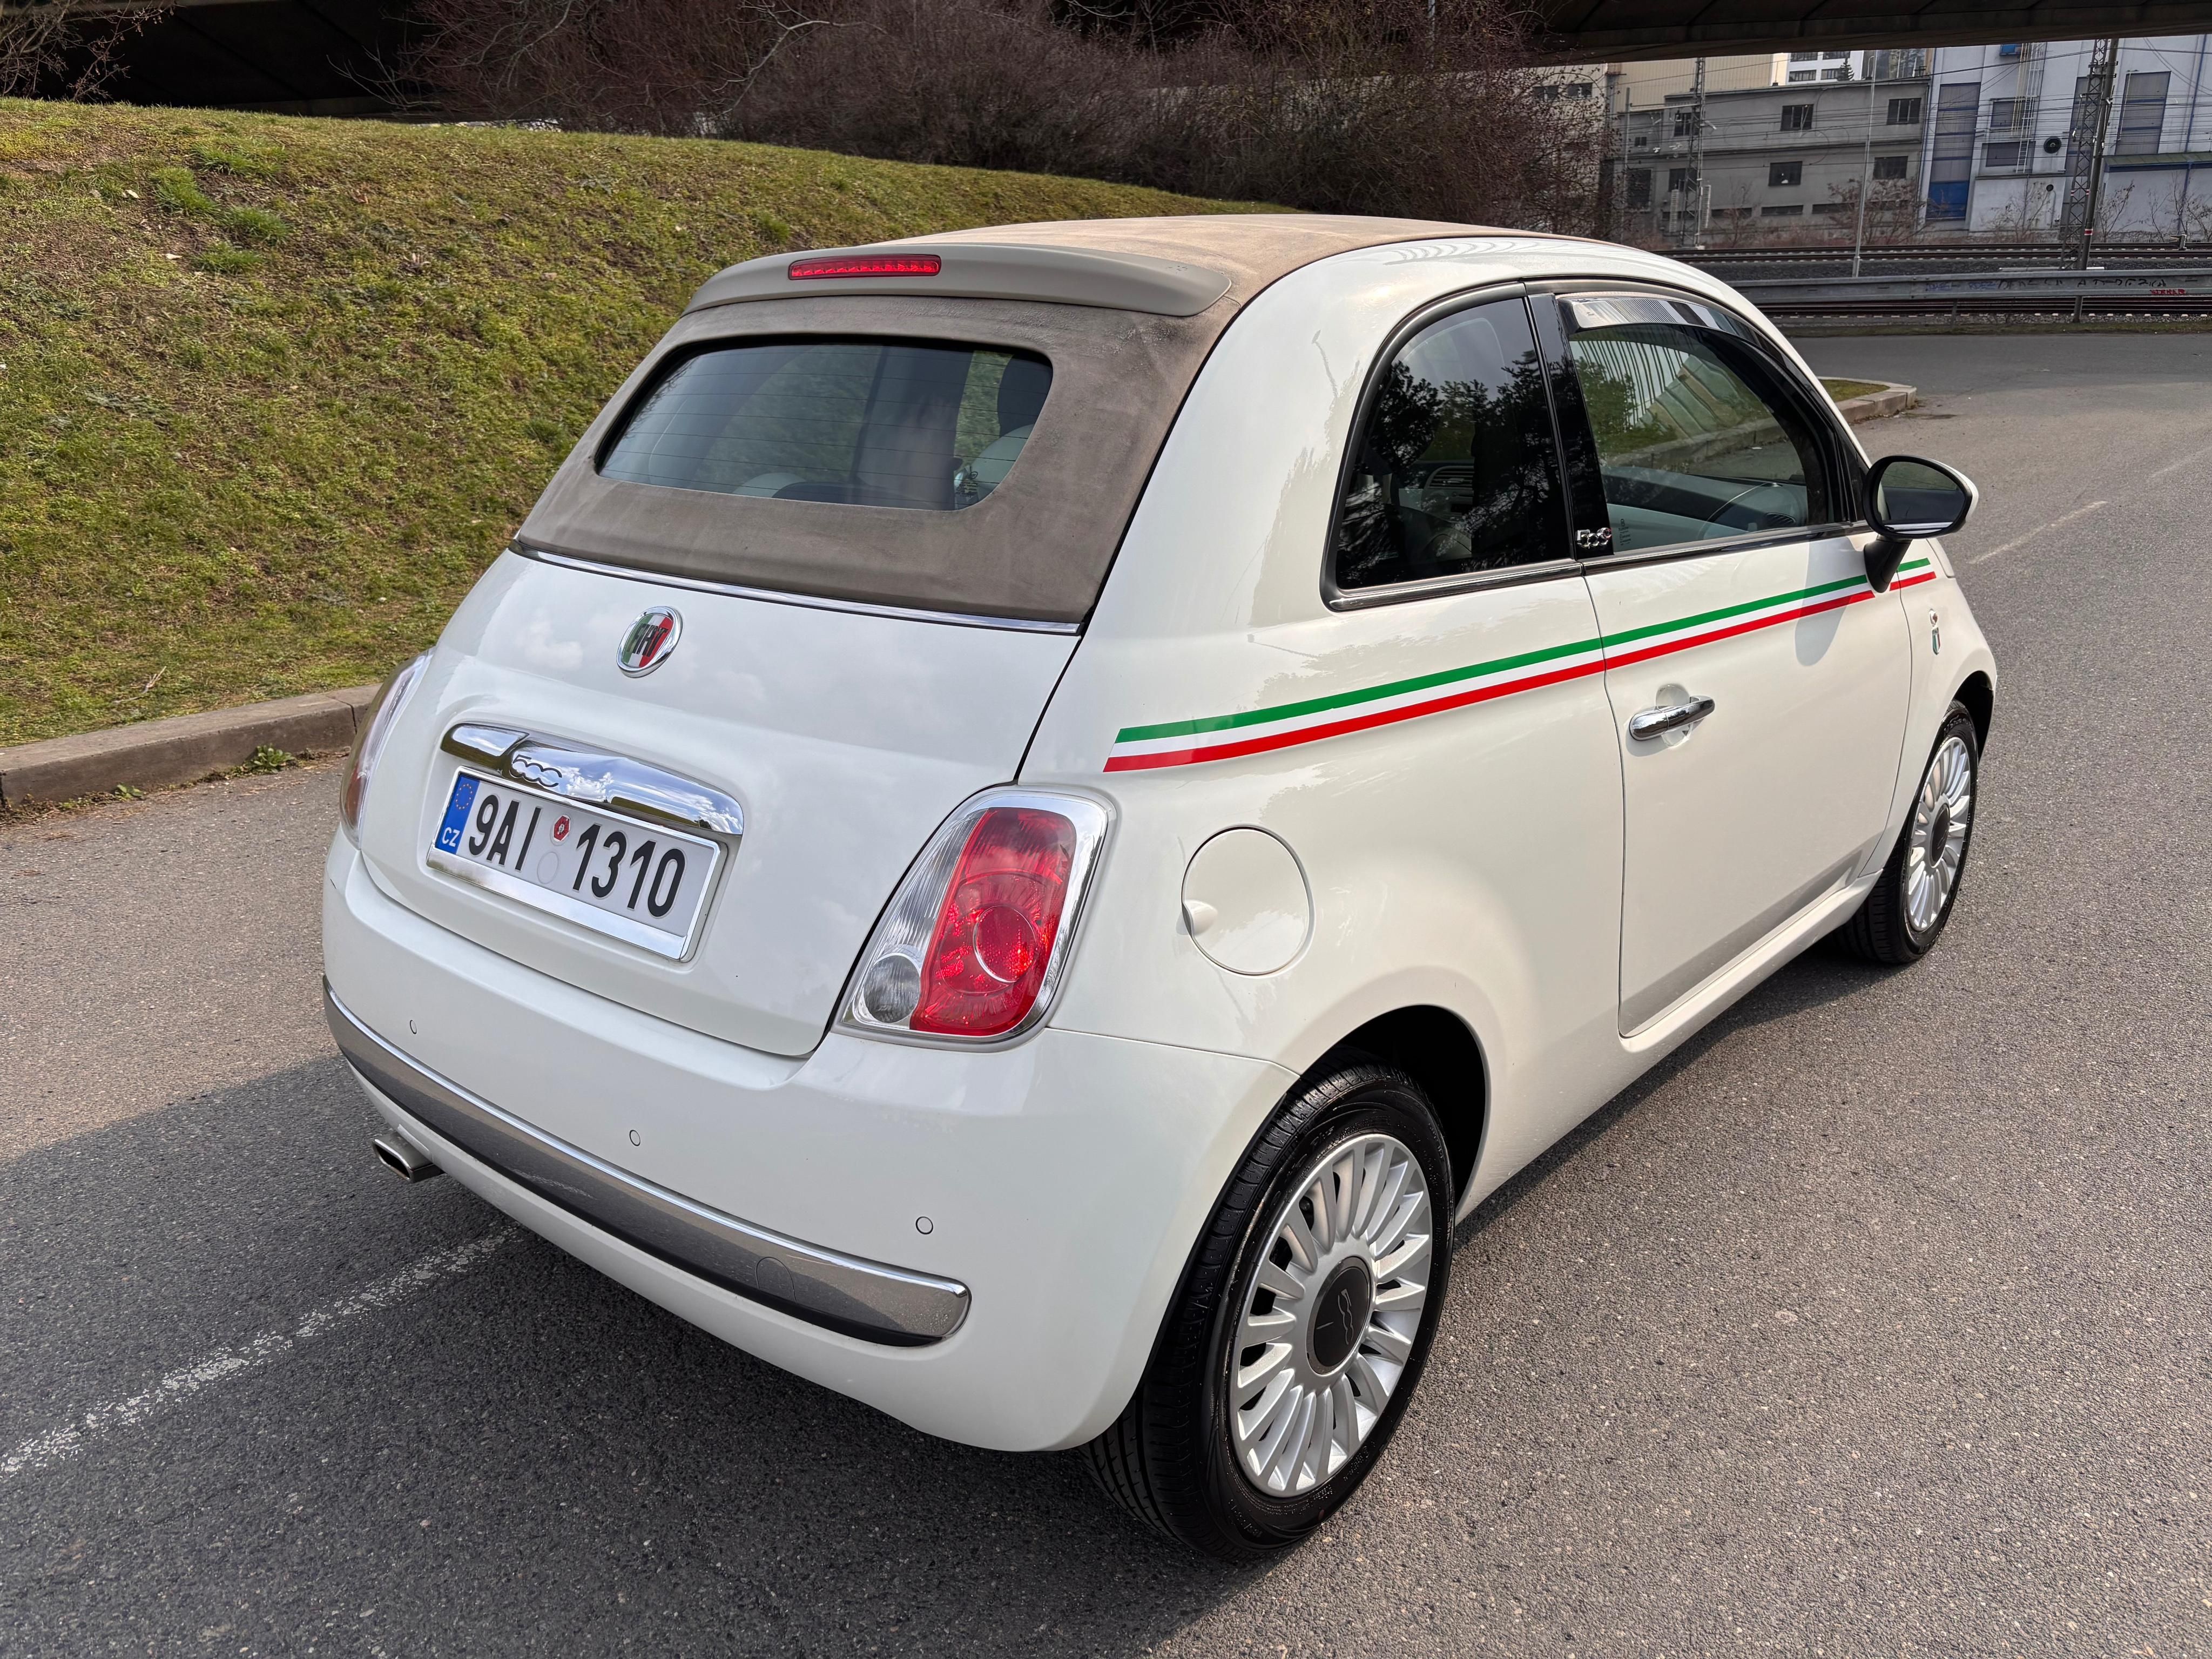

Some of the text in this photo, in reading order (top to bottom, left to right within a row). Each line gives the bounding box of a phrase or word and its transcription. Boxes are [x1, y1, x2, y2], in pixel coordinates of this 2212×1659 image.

[626, 623, 669, 657] FIAT
[441, 827, 461, 848] CZ
[469, 794, 686, 917] 9AI 1310
